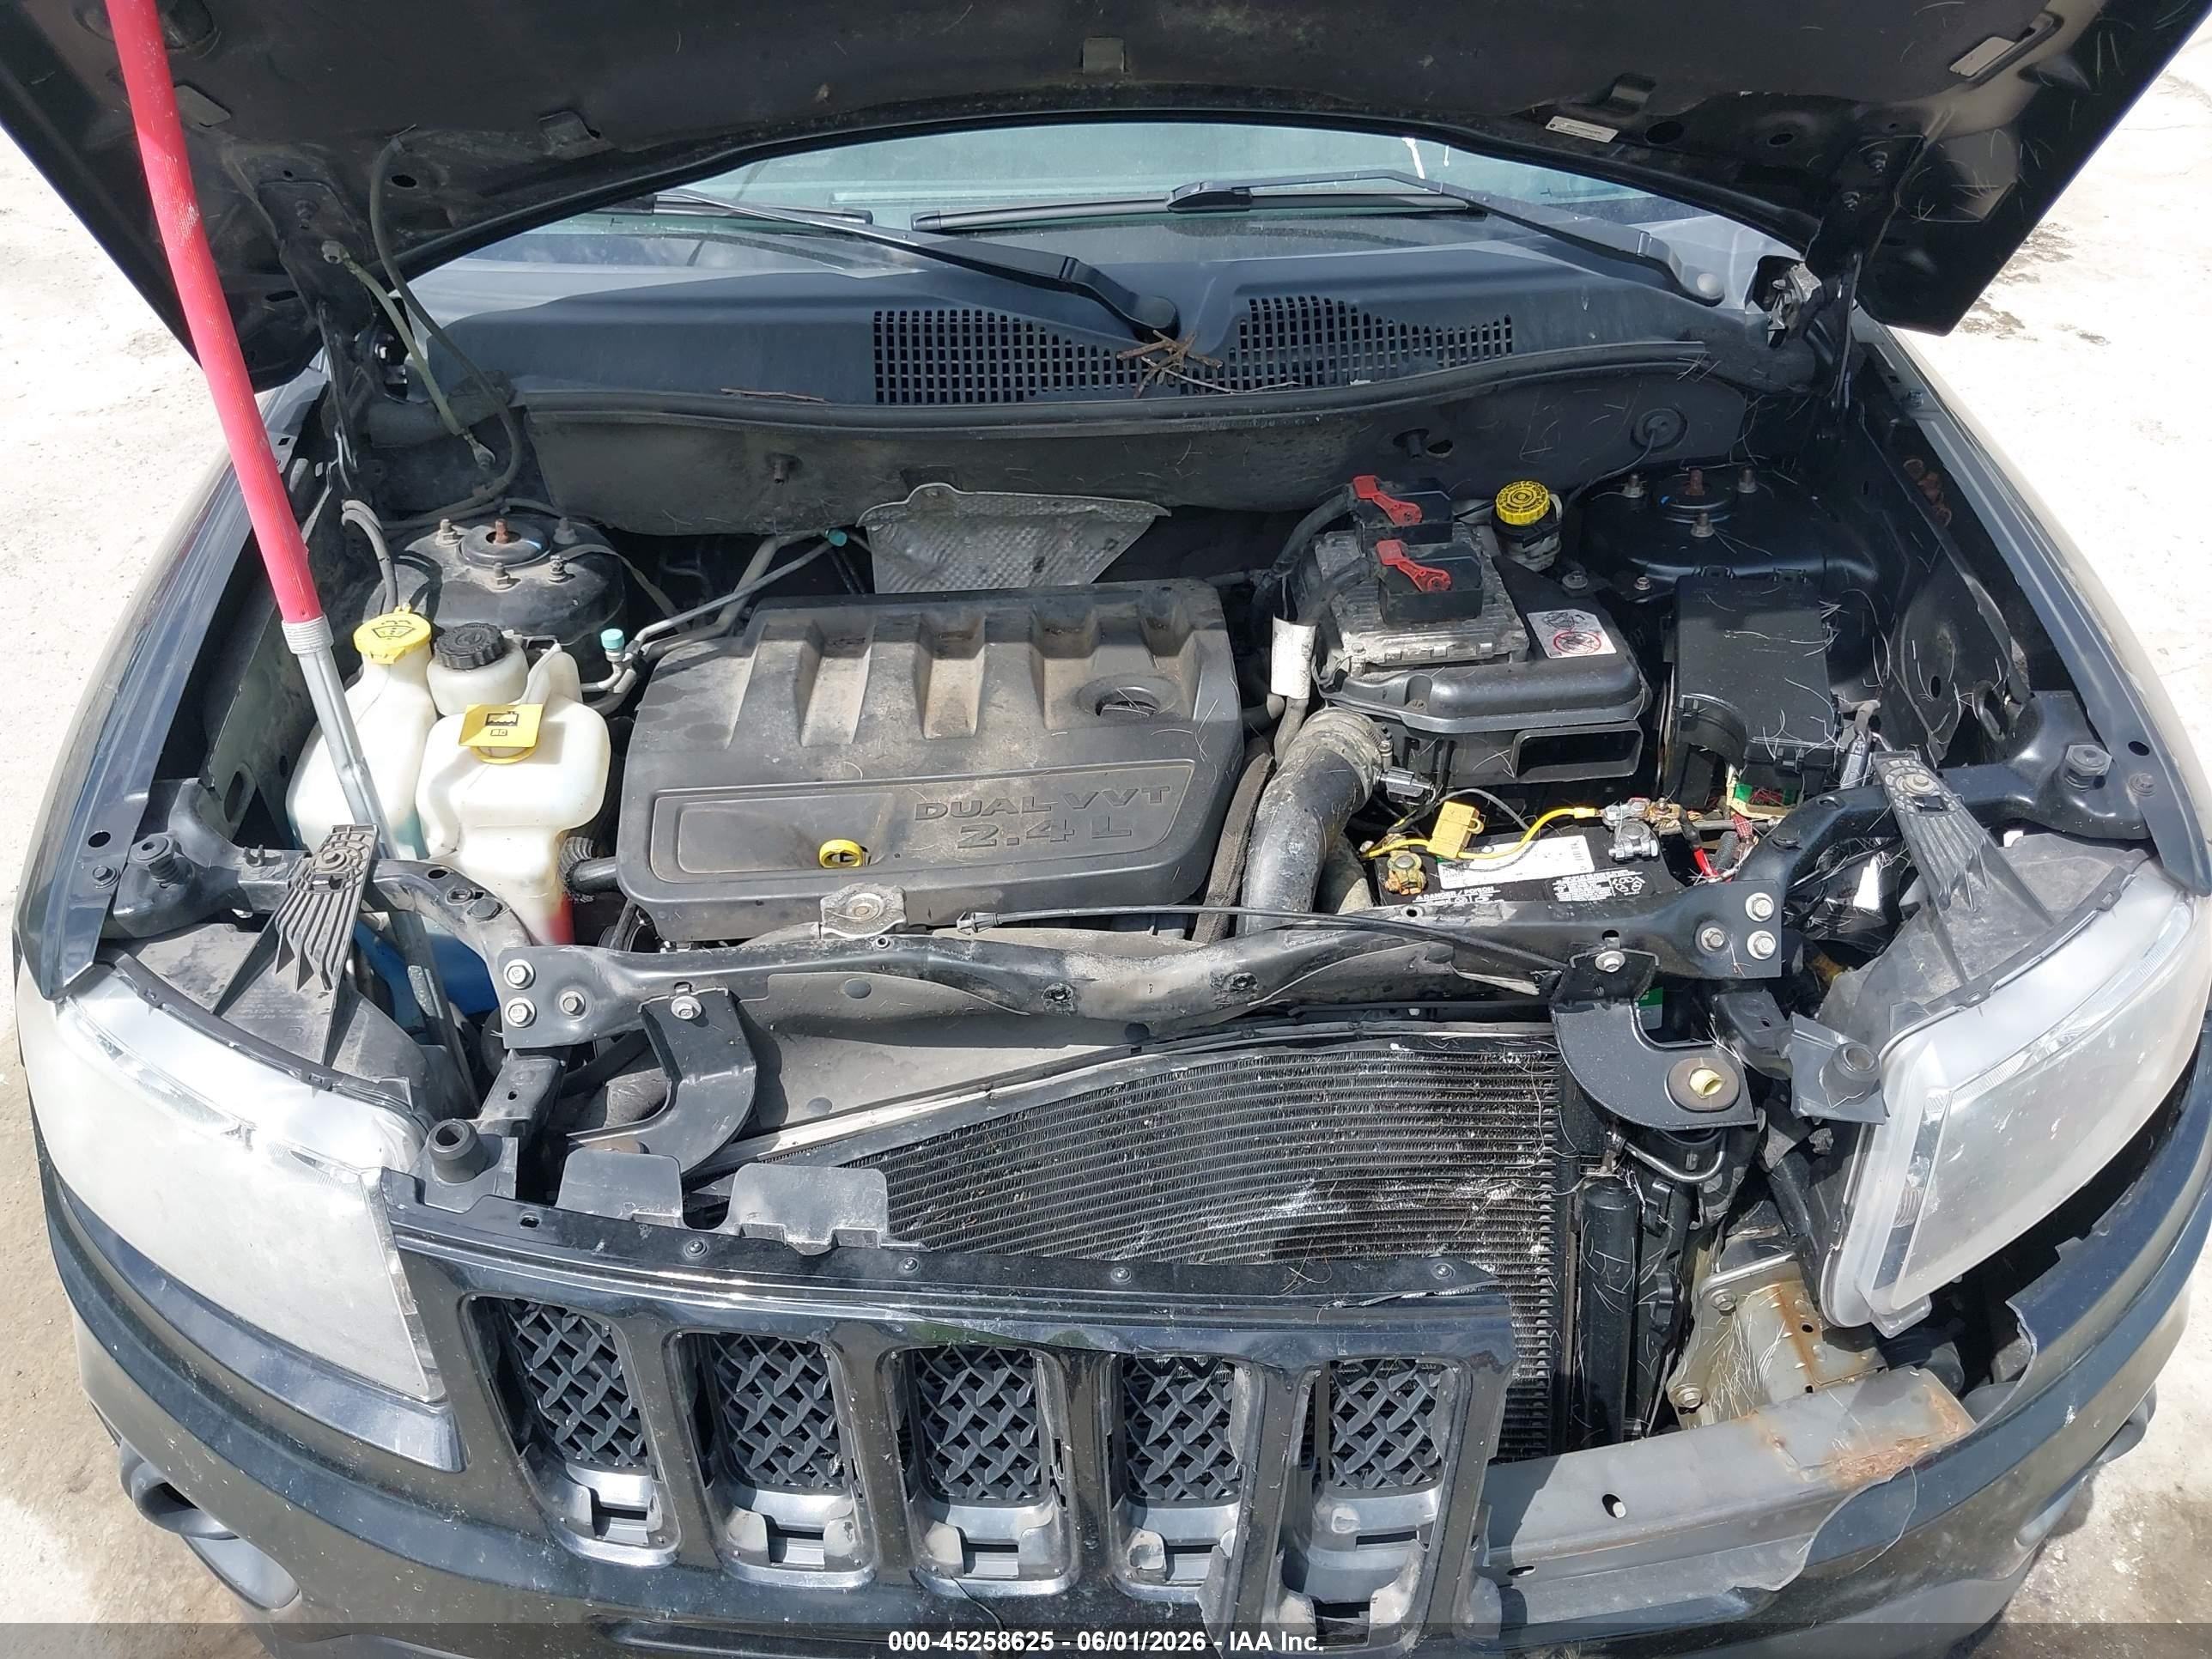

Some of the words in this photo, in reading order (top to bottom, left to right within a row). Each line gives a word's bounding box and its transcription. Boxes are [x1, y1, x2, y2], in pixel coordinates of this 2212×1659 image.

[915, 796, 1052, 821] DUAL
[1063, 786, 1170, 810] VVT
[1464, 885, 1495, 895] POISON
